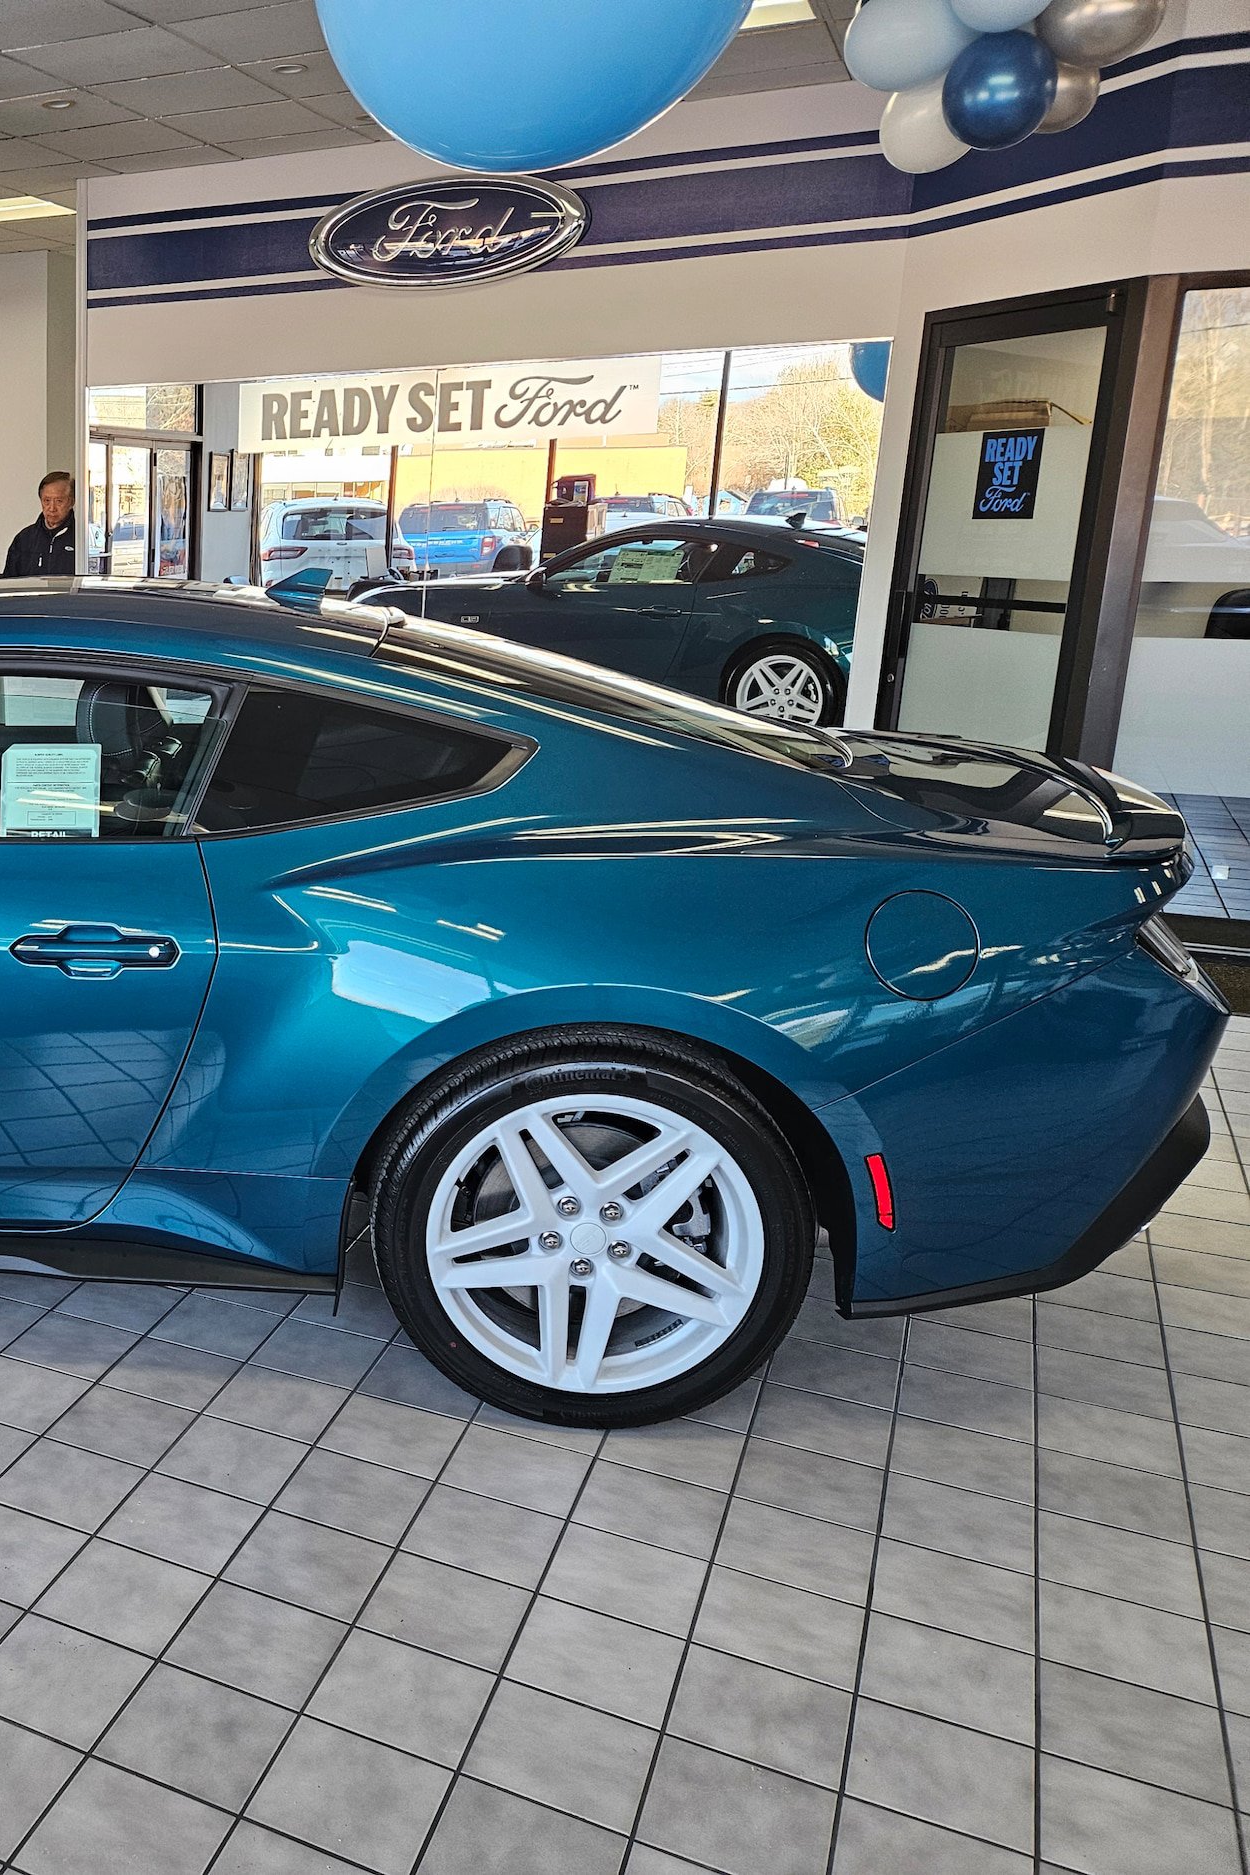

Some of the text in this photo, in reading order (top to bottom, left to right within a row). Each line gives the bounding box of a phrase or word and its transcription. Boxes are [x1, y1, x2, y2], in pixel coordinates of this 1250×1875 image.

[372, 198, 514, 261] Ford
[261, 384, 400, 441] READY
[405, 379, 493, 433] SET
[494, 374, 627, 428] Ford
[984, 435, 1038, 463] READY
[992, 460, 1023, 486] SET
[979, 485, 1027, 512] Ford
